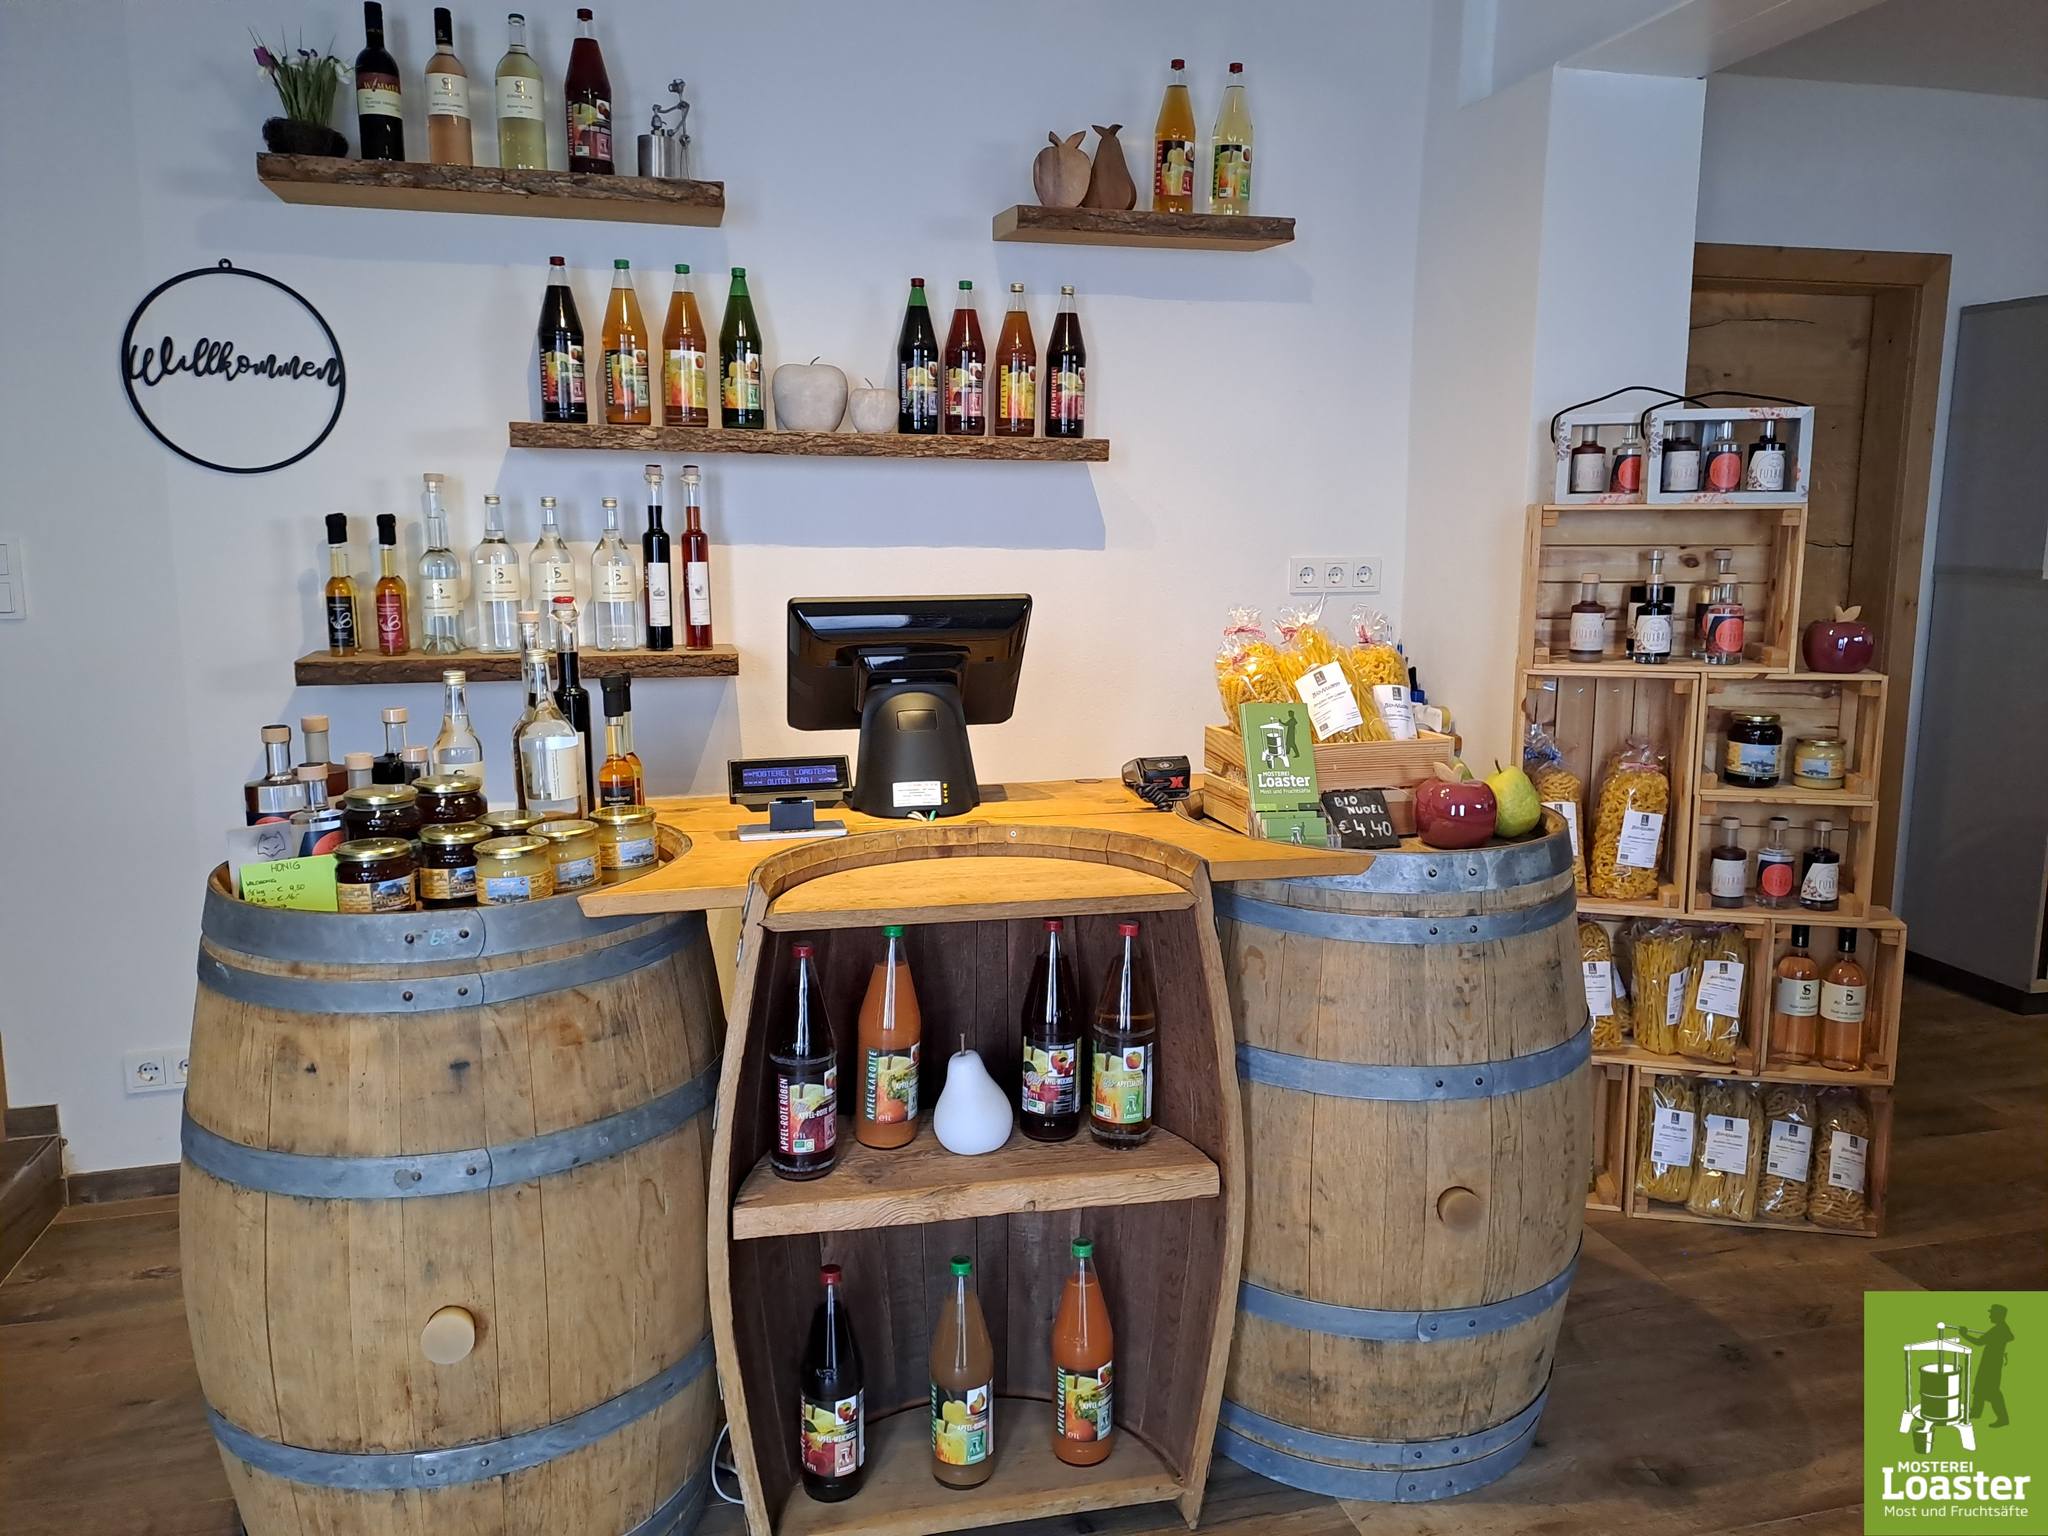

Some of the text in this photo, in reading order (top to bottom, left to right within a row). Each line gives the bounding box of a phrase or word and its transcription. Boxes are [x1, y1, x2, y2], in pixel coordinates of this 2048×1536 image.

[128, 336, 345, 387] Willkommen
[1257, 773, 1311, 787] Loaster
[1334, 795, 1358, 807] BIO
[1345, 804, 1384, 815] NUDEL
[1338, 819, 1392, 838] € 4,40
[271, 861, 301, 872] HONIG
[866, 1049, 878, 1120] APFEL-KAROTTE
[778, 1078, 789, 1152] APFEL-ROTE RÜBEN
[1057, 1366, 1066, 1435] APFEL-KAROTTE
